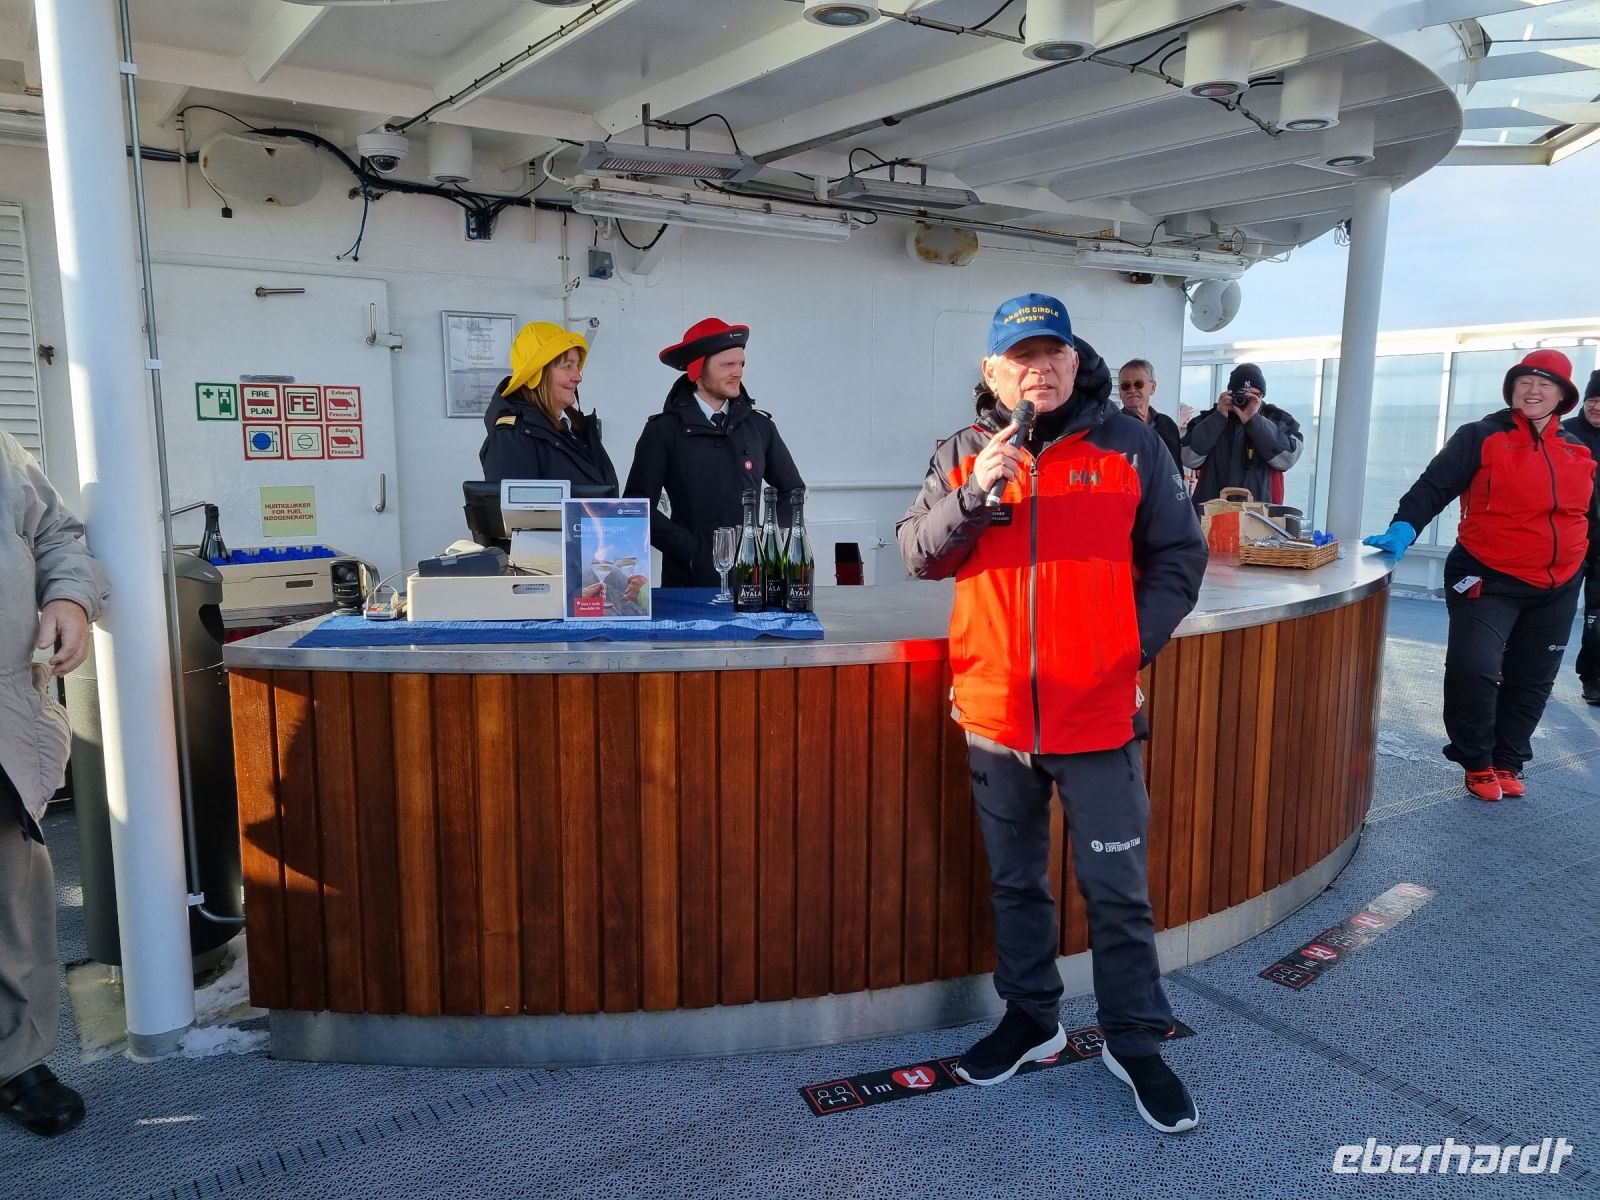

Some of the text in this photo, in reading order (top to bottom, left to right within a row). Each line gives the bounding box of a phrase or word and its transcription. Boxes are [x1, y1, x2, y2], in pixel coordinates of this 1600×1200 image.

[251, 390, 270, 398] FIRE
[290, 395, 316, 412] FE
[250, 407, 273, 415] PLAN
[740, 587, 762, 597] AYALA
[789, 587, 811, 597] AYALA
[861, 1084, 872, 1096] 1
[874, 1083, 893, 1093] m
